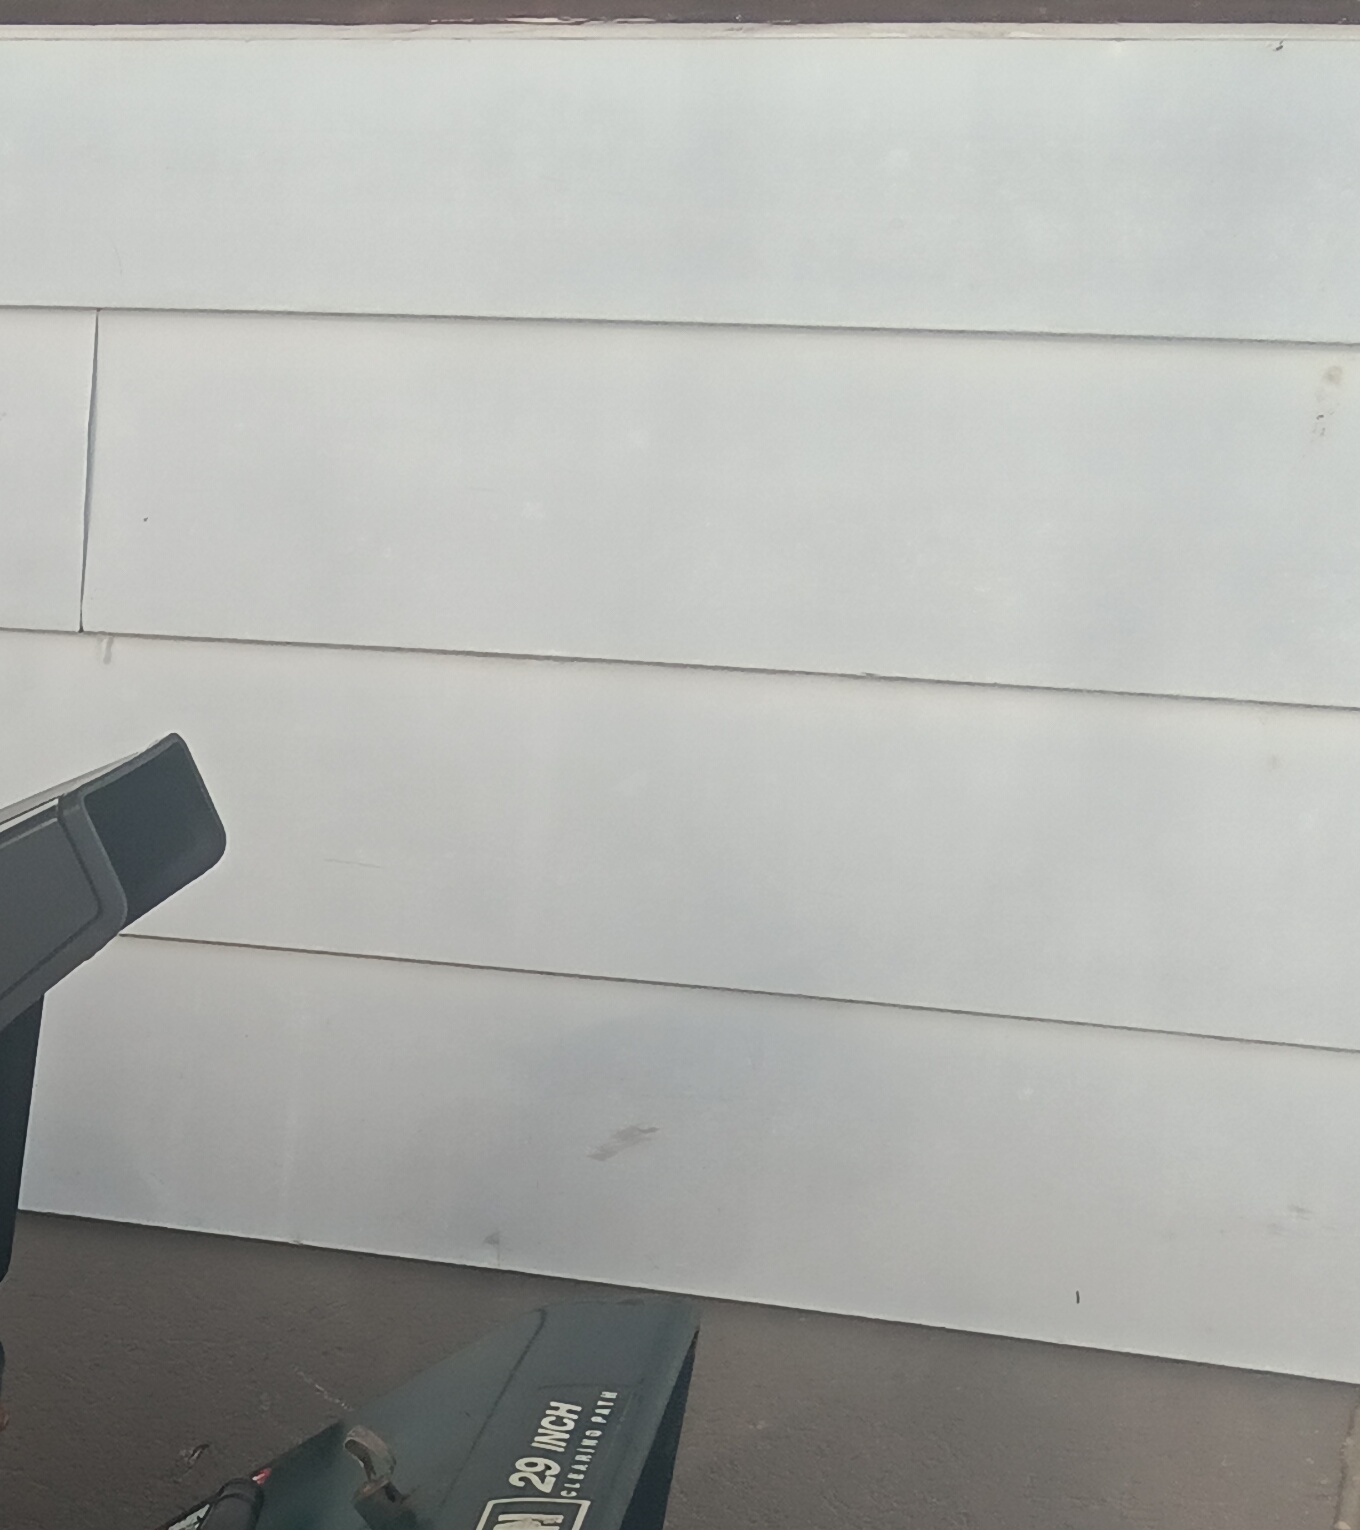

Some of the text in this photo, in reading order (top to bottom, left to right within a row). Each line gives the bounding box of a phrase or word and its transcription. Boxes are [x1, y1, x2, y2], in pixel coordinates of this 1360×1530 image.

[508, 1401, 582, 1493] 29 INCH
[560, 1391, 618, 1497] CLEARING PATH
